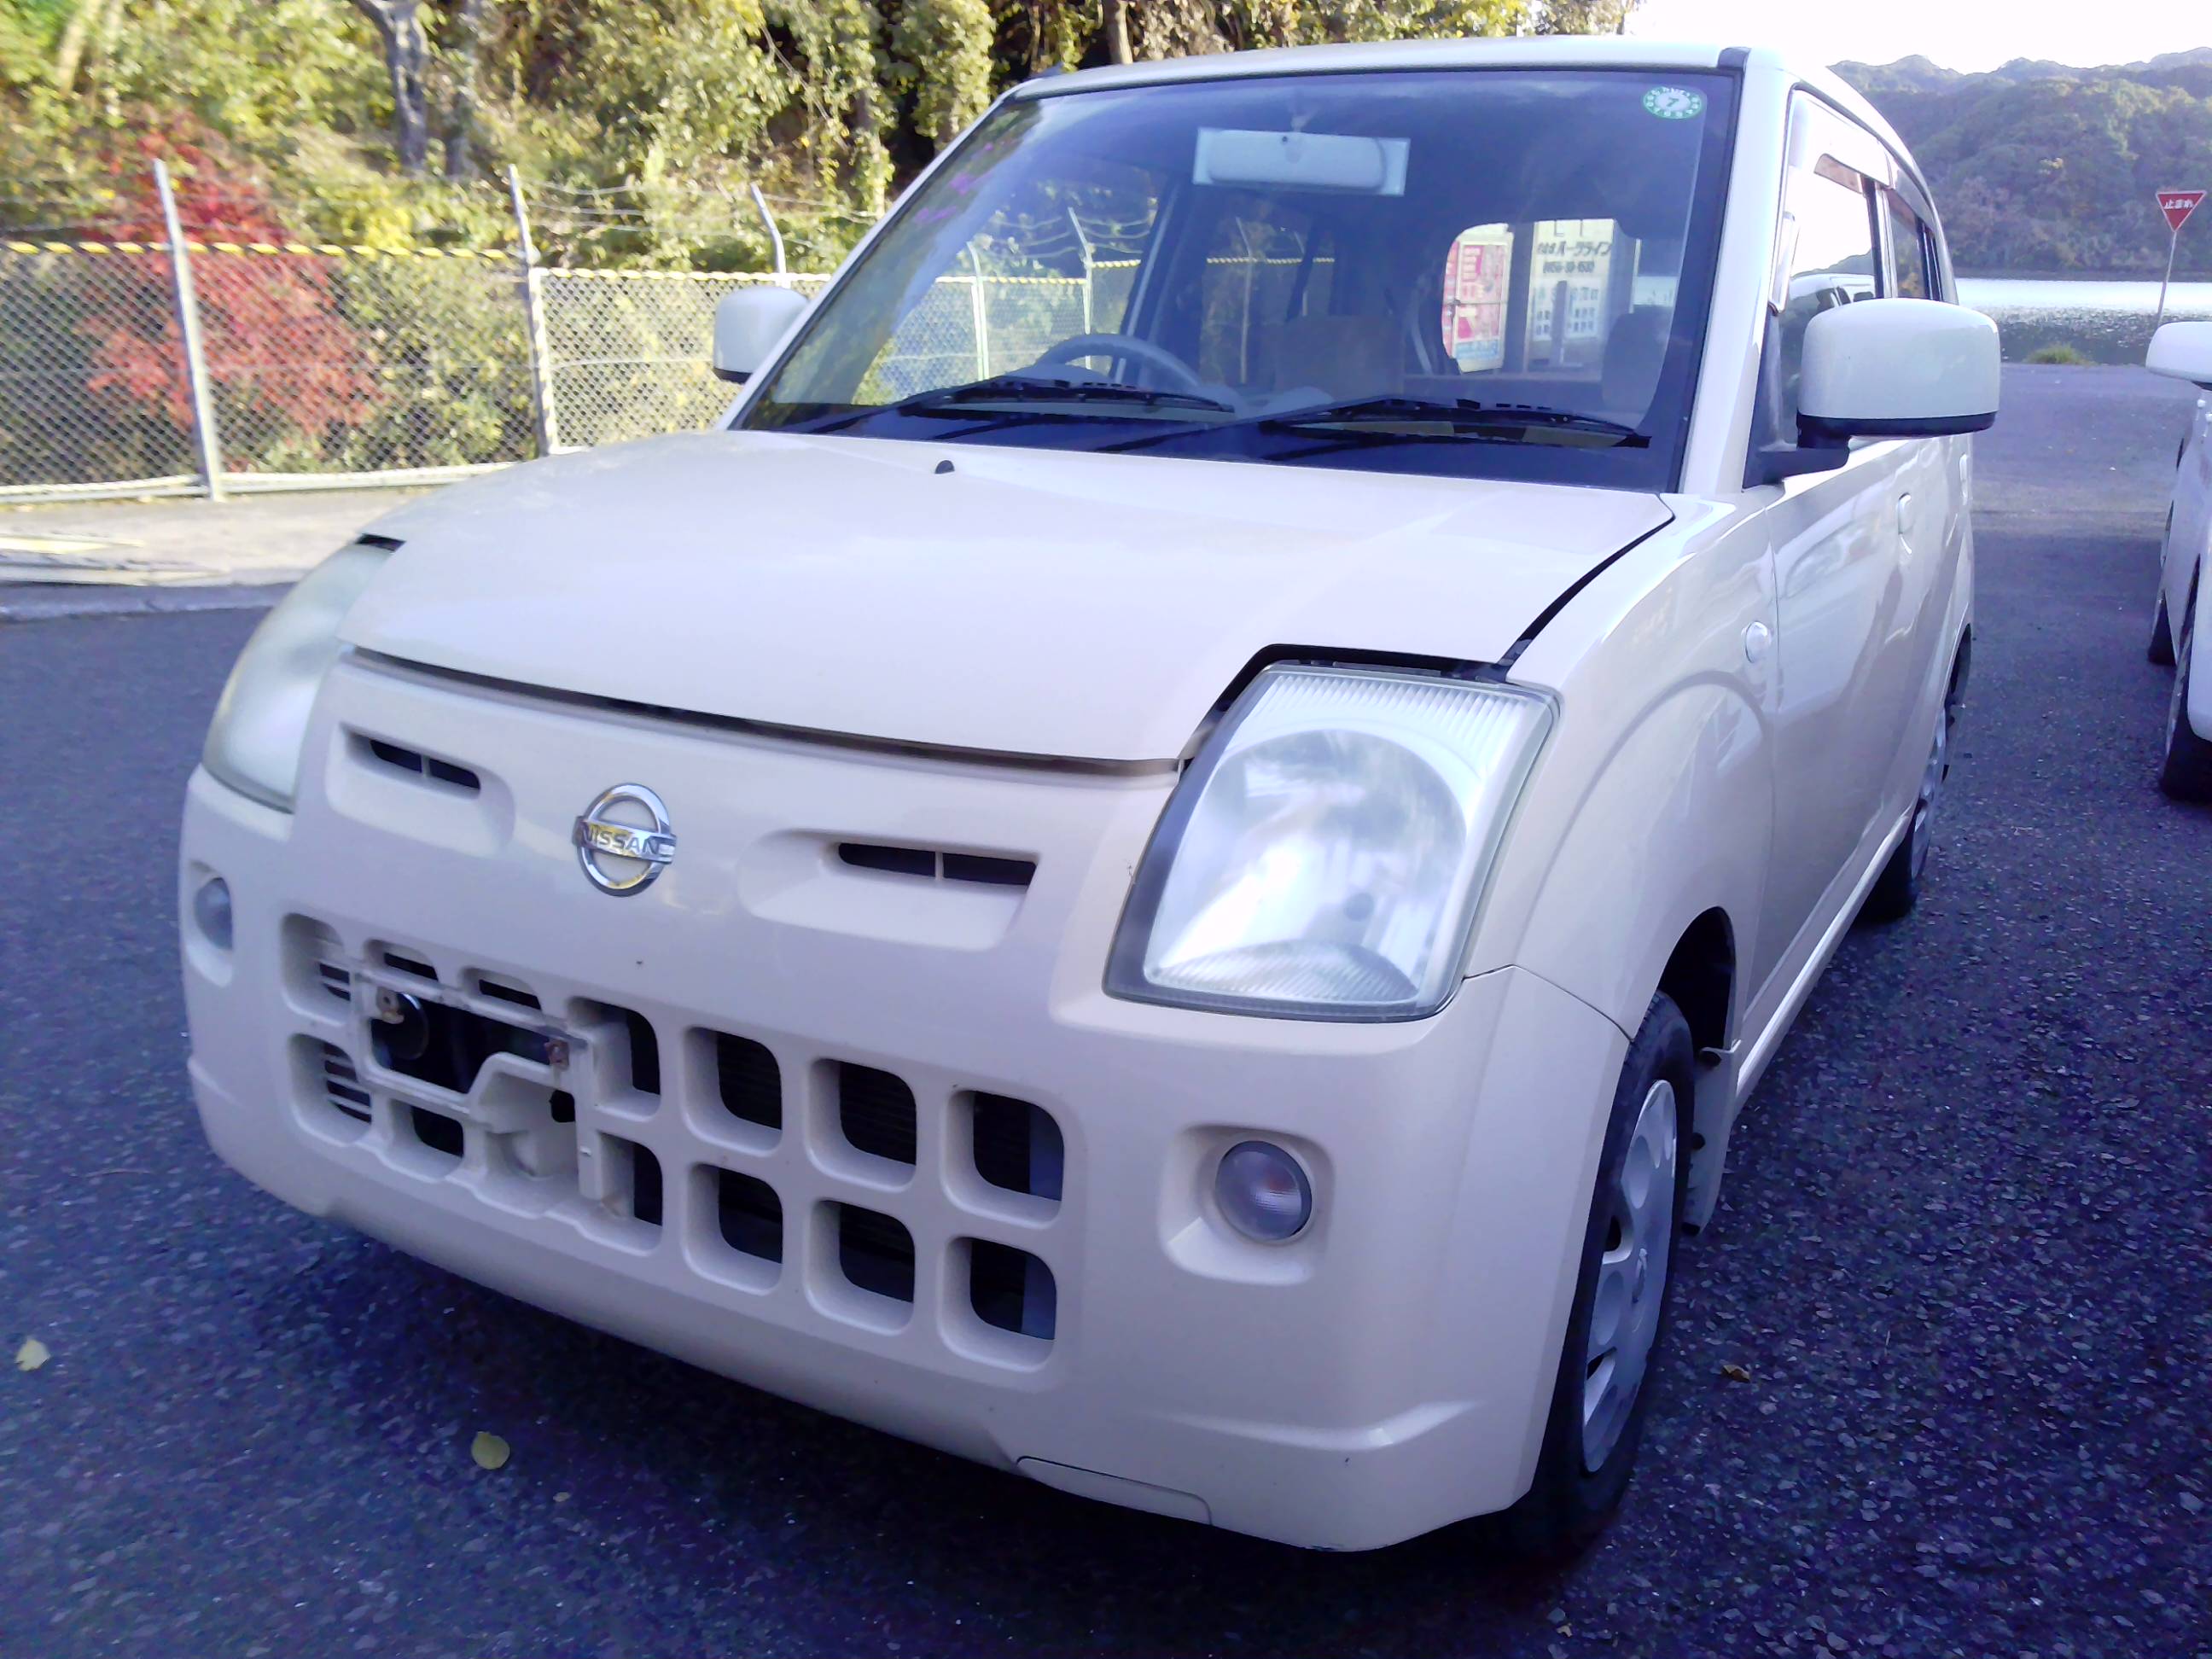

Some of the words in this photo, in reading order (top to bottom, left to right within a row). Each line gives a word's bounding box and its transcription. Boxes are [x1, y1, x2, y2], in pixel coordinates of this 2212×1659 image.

[2163, 199, 2194, 210] 止まれ
[583, 822, 661, 856] NISSAN
